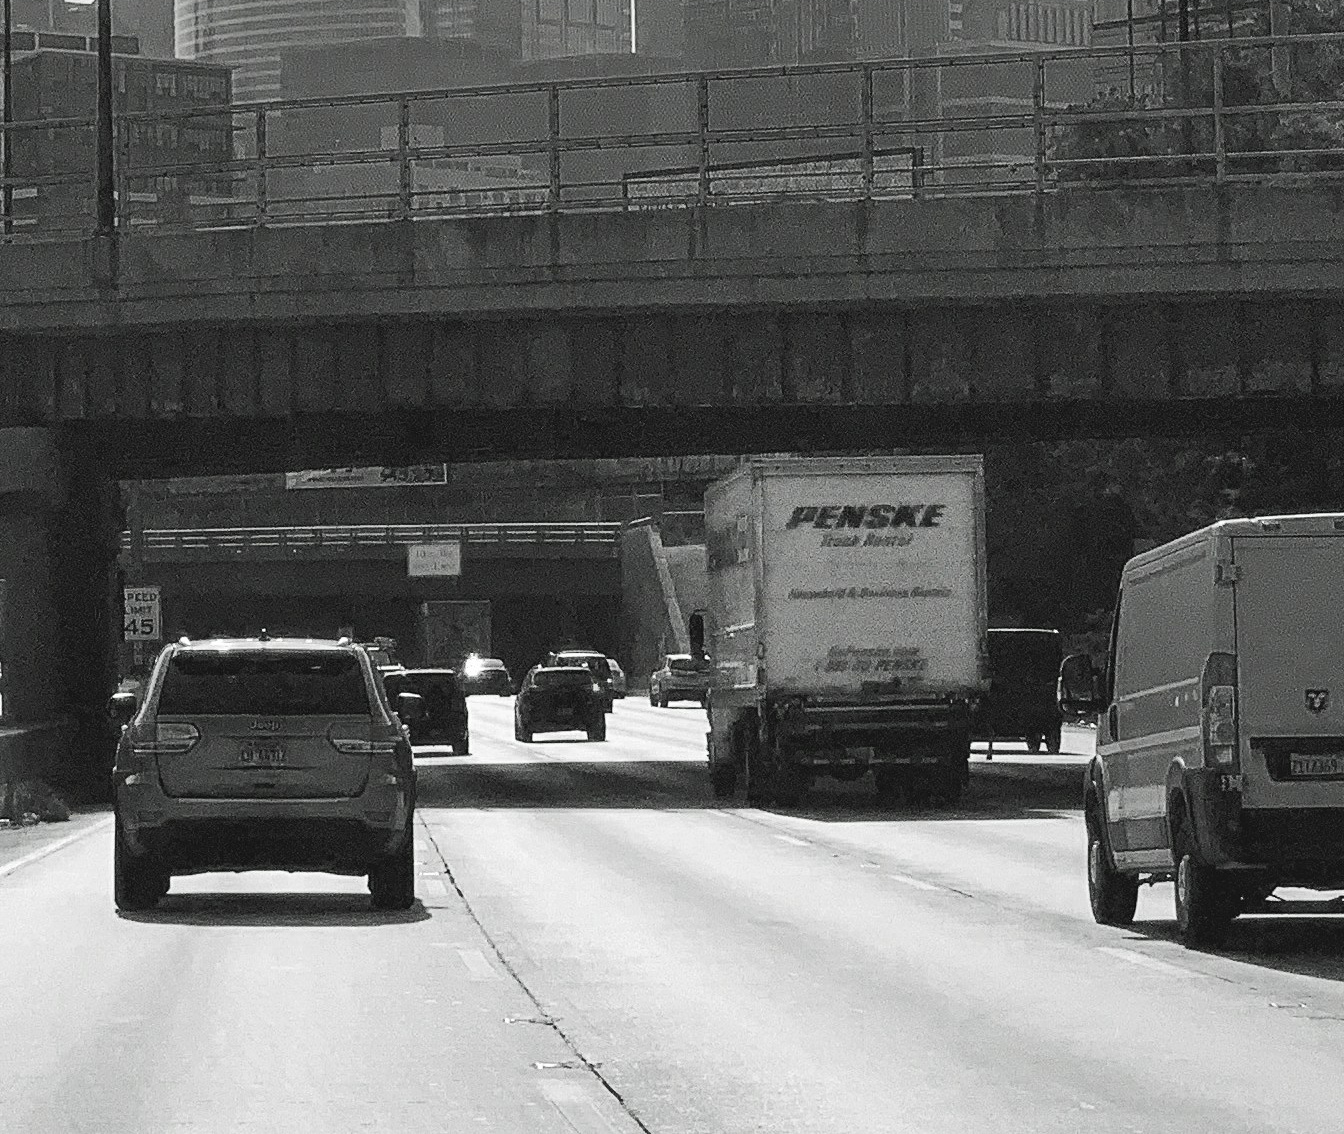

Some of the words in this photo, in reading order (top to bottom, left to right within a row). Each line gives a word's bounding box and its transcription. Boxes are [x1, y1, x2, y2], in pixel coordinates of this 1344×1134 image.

[786, 504, 947, 529] PENSKE
[126, 592, 157, 602] PEED
[123, 618, 154, 635] 45
[249, 719, 282, 731] Jeep
